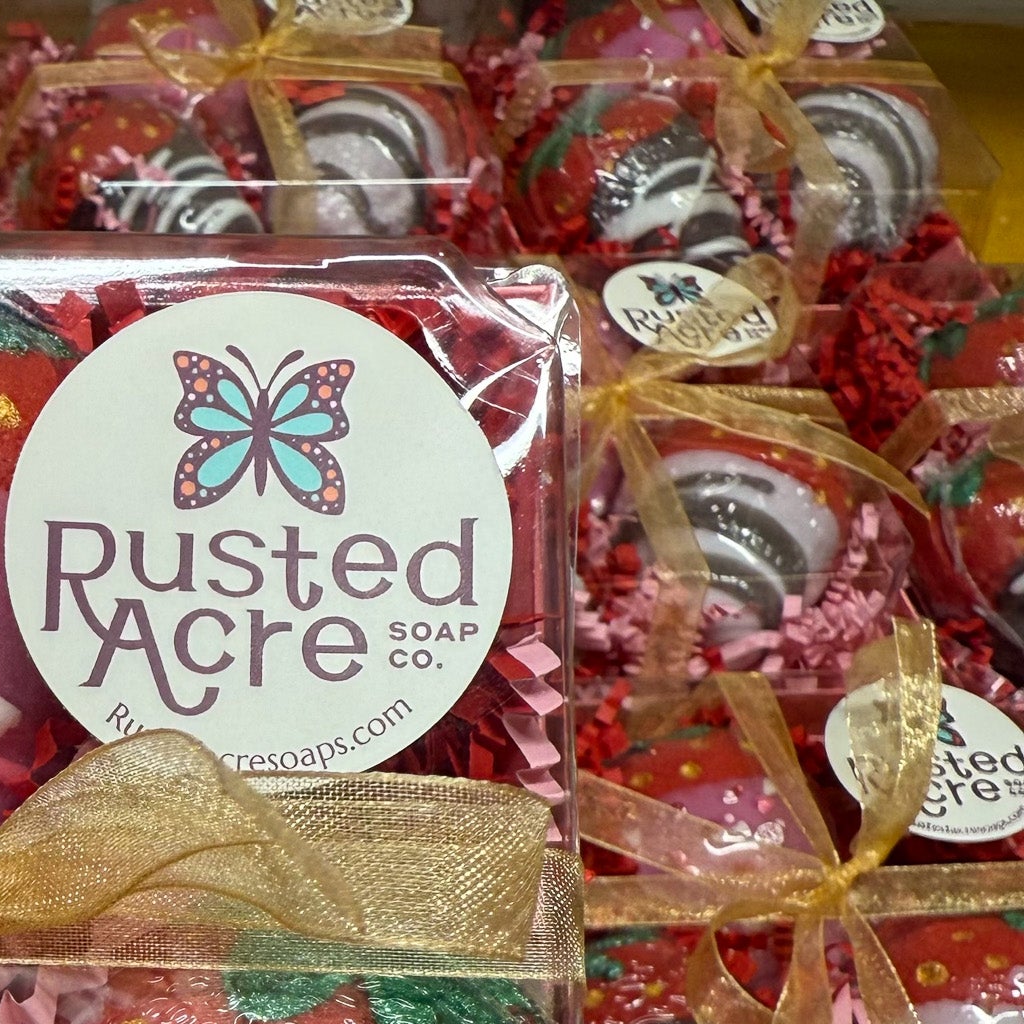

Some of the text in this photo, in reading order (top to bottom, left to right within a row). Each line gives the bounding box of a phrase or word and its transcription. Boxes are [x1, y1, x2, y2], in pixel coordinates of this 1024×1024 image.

[40, 518, 479, 632] Rusted
[78, 598, 368, 716] Acre
[388, 621, 479, 643] SOAP
[388, 649, 444, 670] CO.
